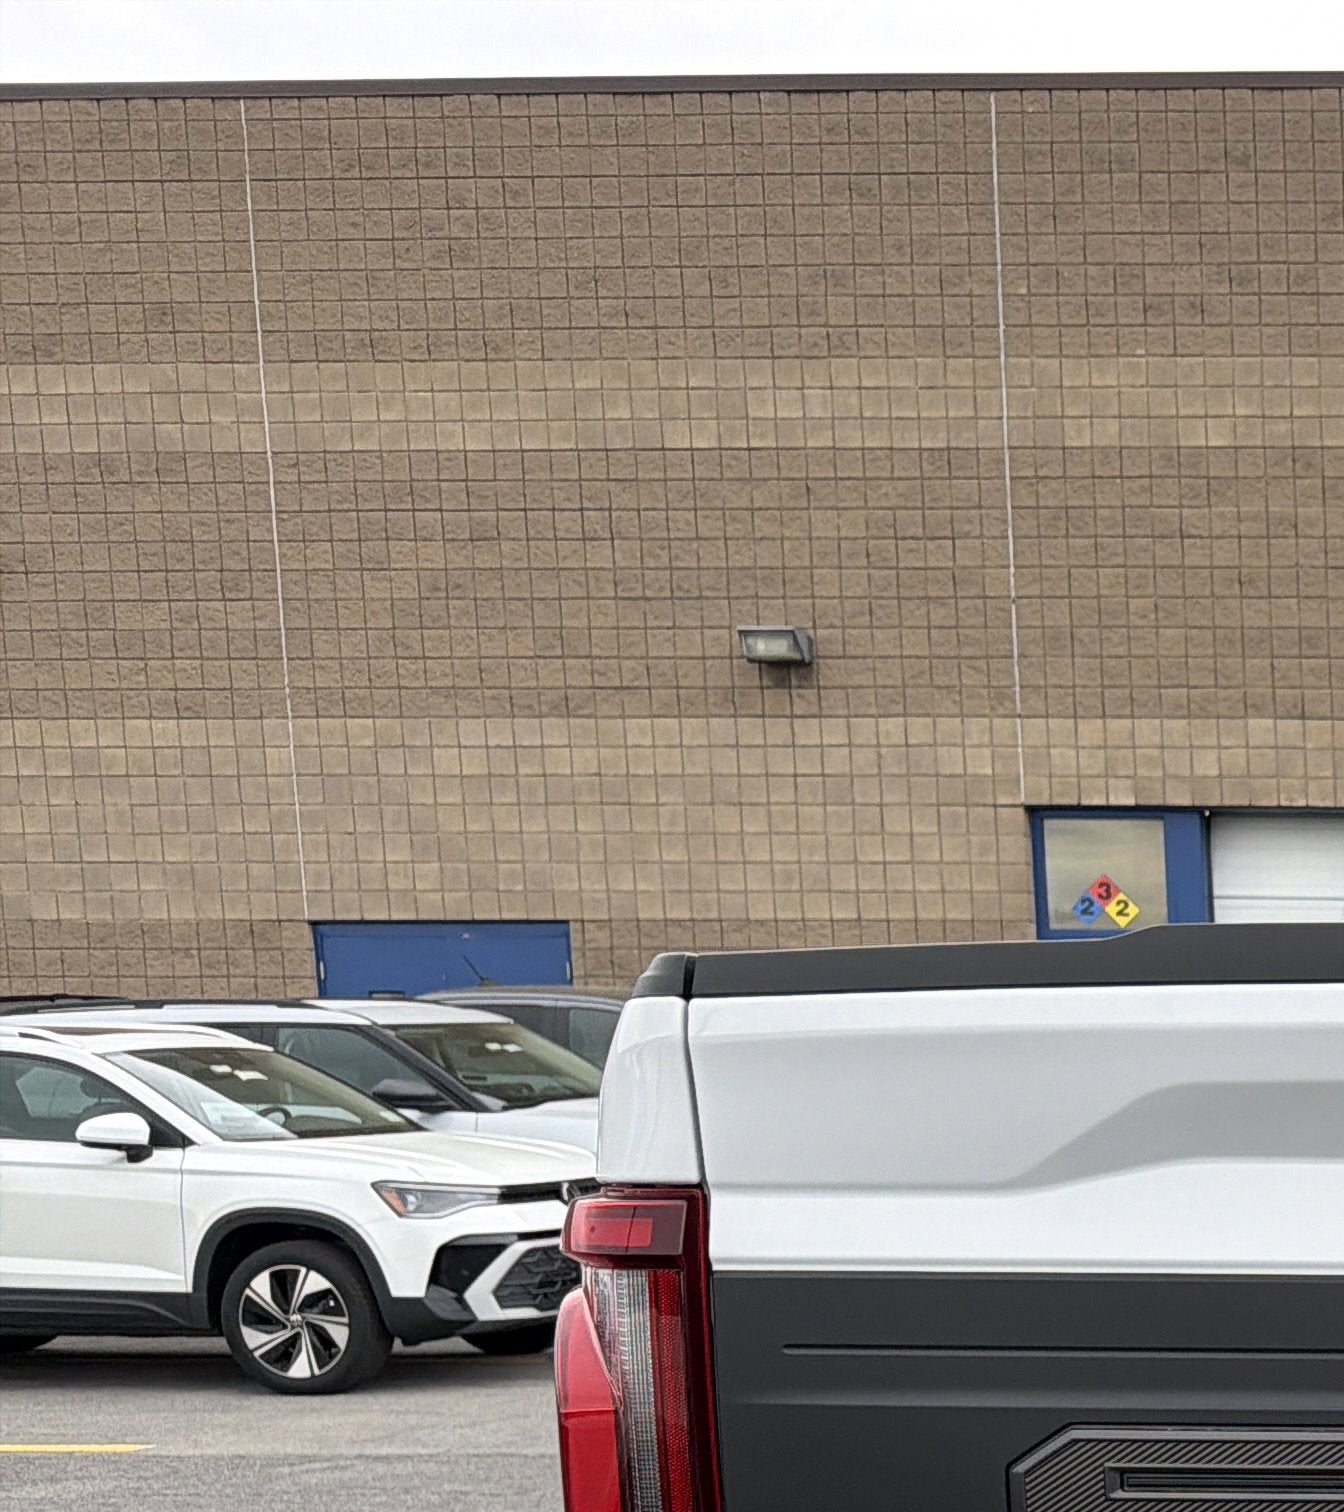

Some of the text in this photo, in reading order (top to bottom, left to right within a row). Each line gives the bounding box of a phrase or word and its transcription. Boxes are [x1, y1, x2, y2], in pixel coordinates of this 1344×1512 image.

[1097, 882, 1111, 901] 3
[1080, 896, 1095, 916] 2
[1115, 899, 1130, 917] 2
